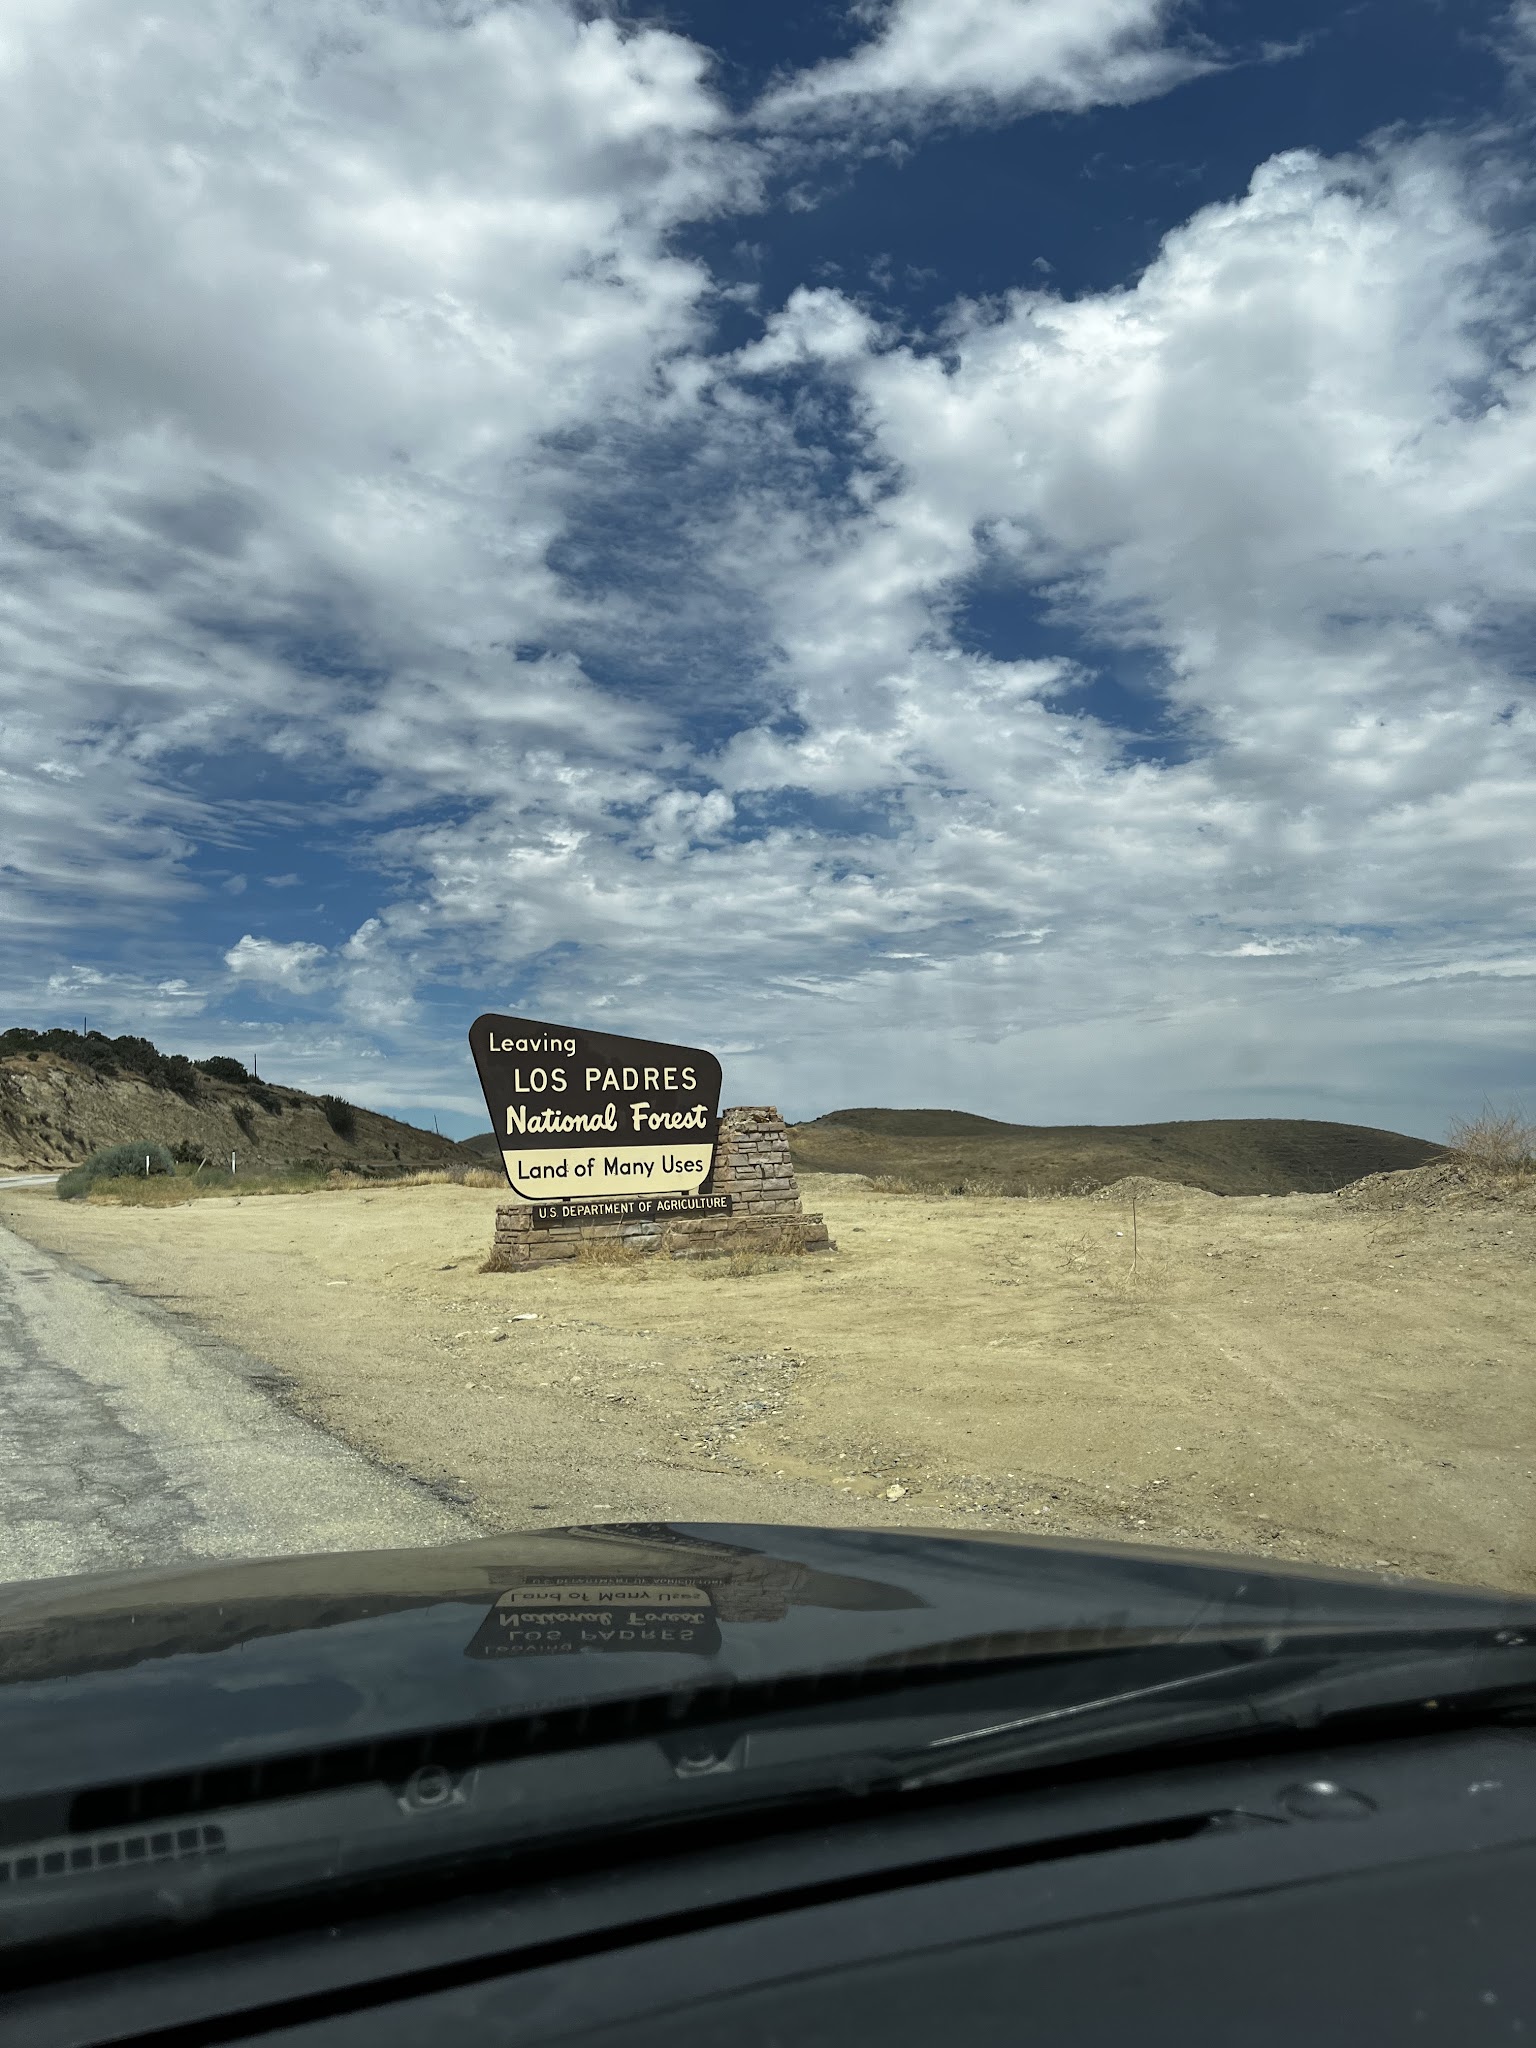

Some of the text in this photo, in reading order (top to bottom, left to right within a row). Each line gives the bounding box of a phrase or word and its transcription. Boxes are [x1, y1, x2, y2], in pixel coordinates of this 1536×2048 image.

[489, 1032, 576, 1057] Leaving
[514, 1066, 698, 1093] LOS PADRES
[506, 1101, 708, 1135] National Forest
[518, 1155, 703, 1180] Land of Many Uses
[562, 1202, 634, 1217] DEPARTMENT
[639, 1201, 652, 1213] OF
[657, 1196, 727, 1211] AGRICULTURE
